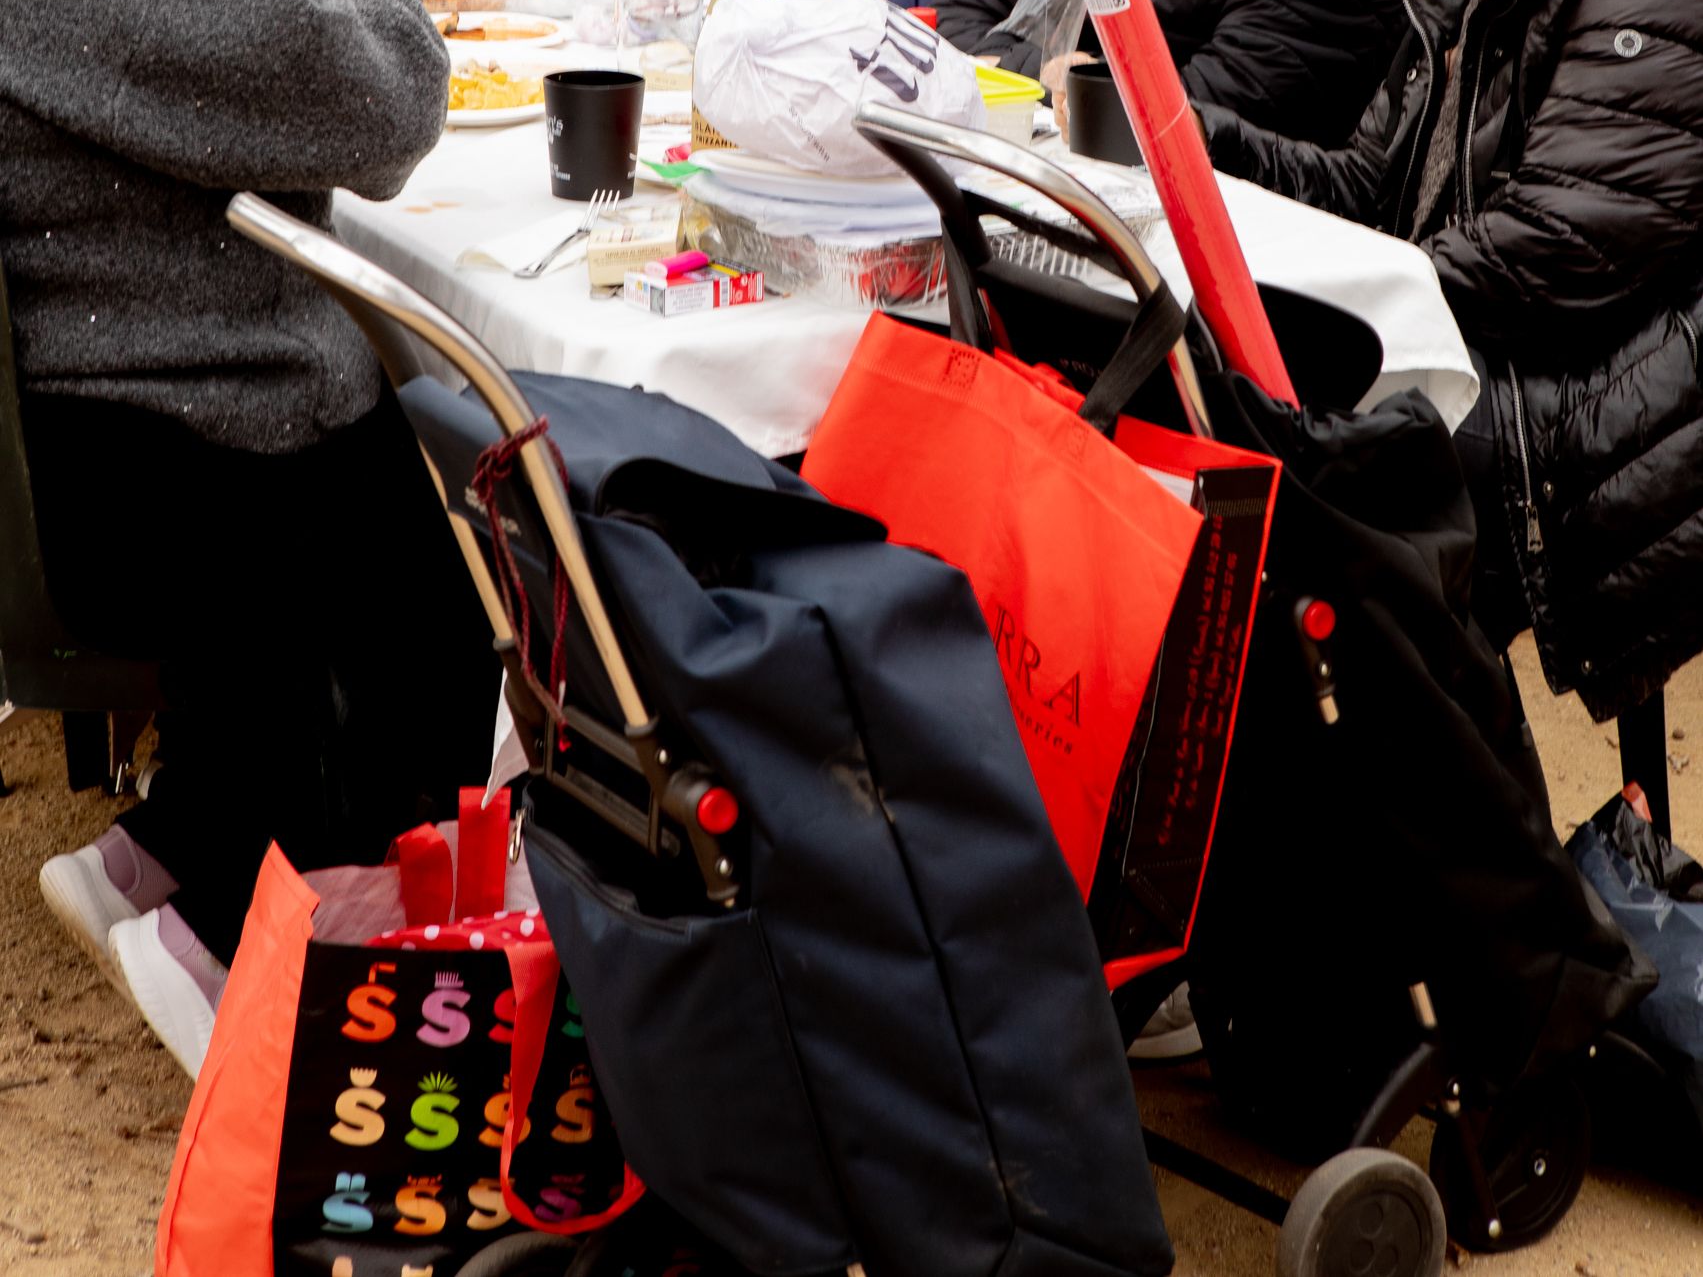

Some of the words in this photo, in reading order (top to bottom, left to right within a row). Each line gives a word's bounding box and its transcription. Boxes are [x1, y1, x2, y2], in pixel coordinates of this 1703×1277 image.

[341, 984, 397, 1043] S
[416, 989, 471, 1047] S
[329, 1087, 386, 1146] S
[404, 1091, 460, 1150] S
[393, 1185, 446, 1235] S
